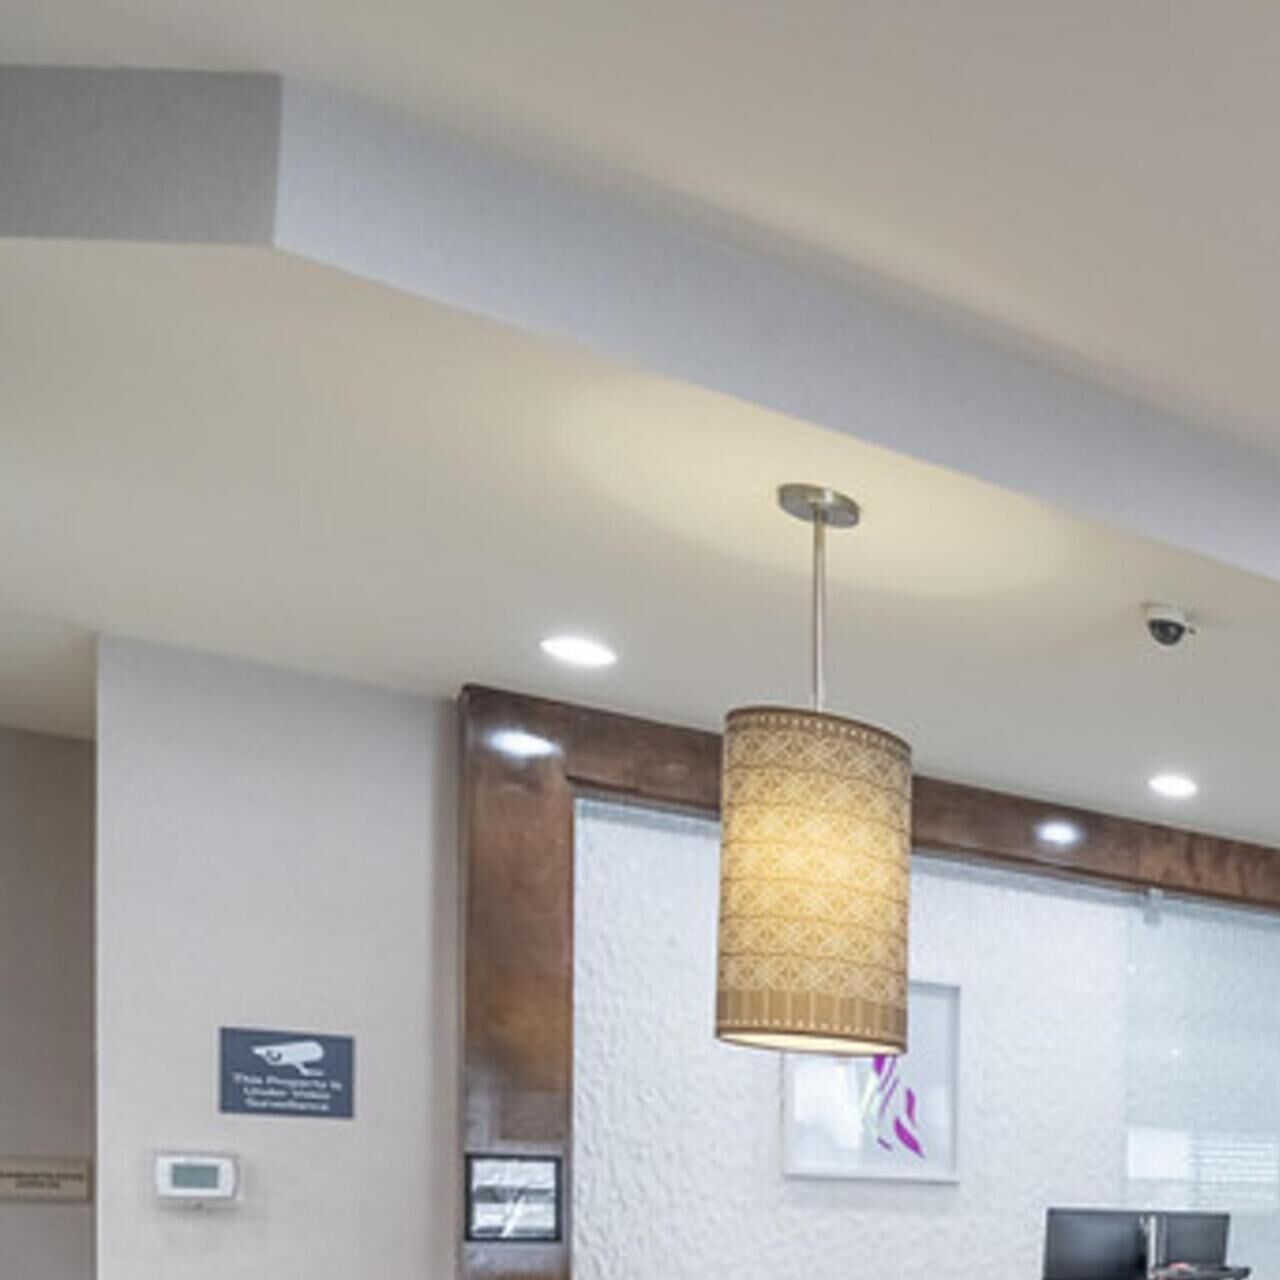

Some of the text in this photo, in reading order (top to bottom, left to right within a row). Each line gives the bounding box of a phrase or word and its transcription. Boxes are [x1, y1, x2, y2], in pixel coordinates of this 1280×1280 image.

[265, 1076, 327, 1090] Property
[243, 1086, 288, 1097] Under
[243, 1097, 330, 1111] Surveillance
